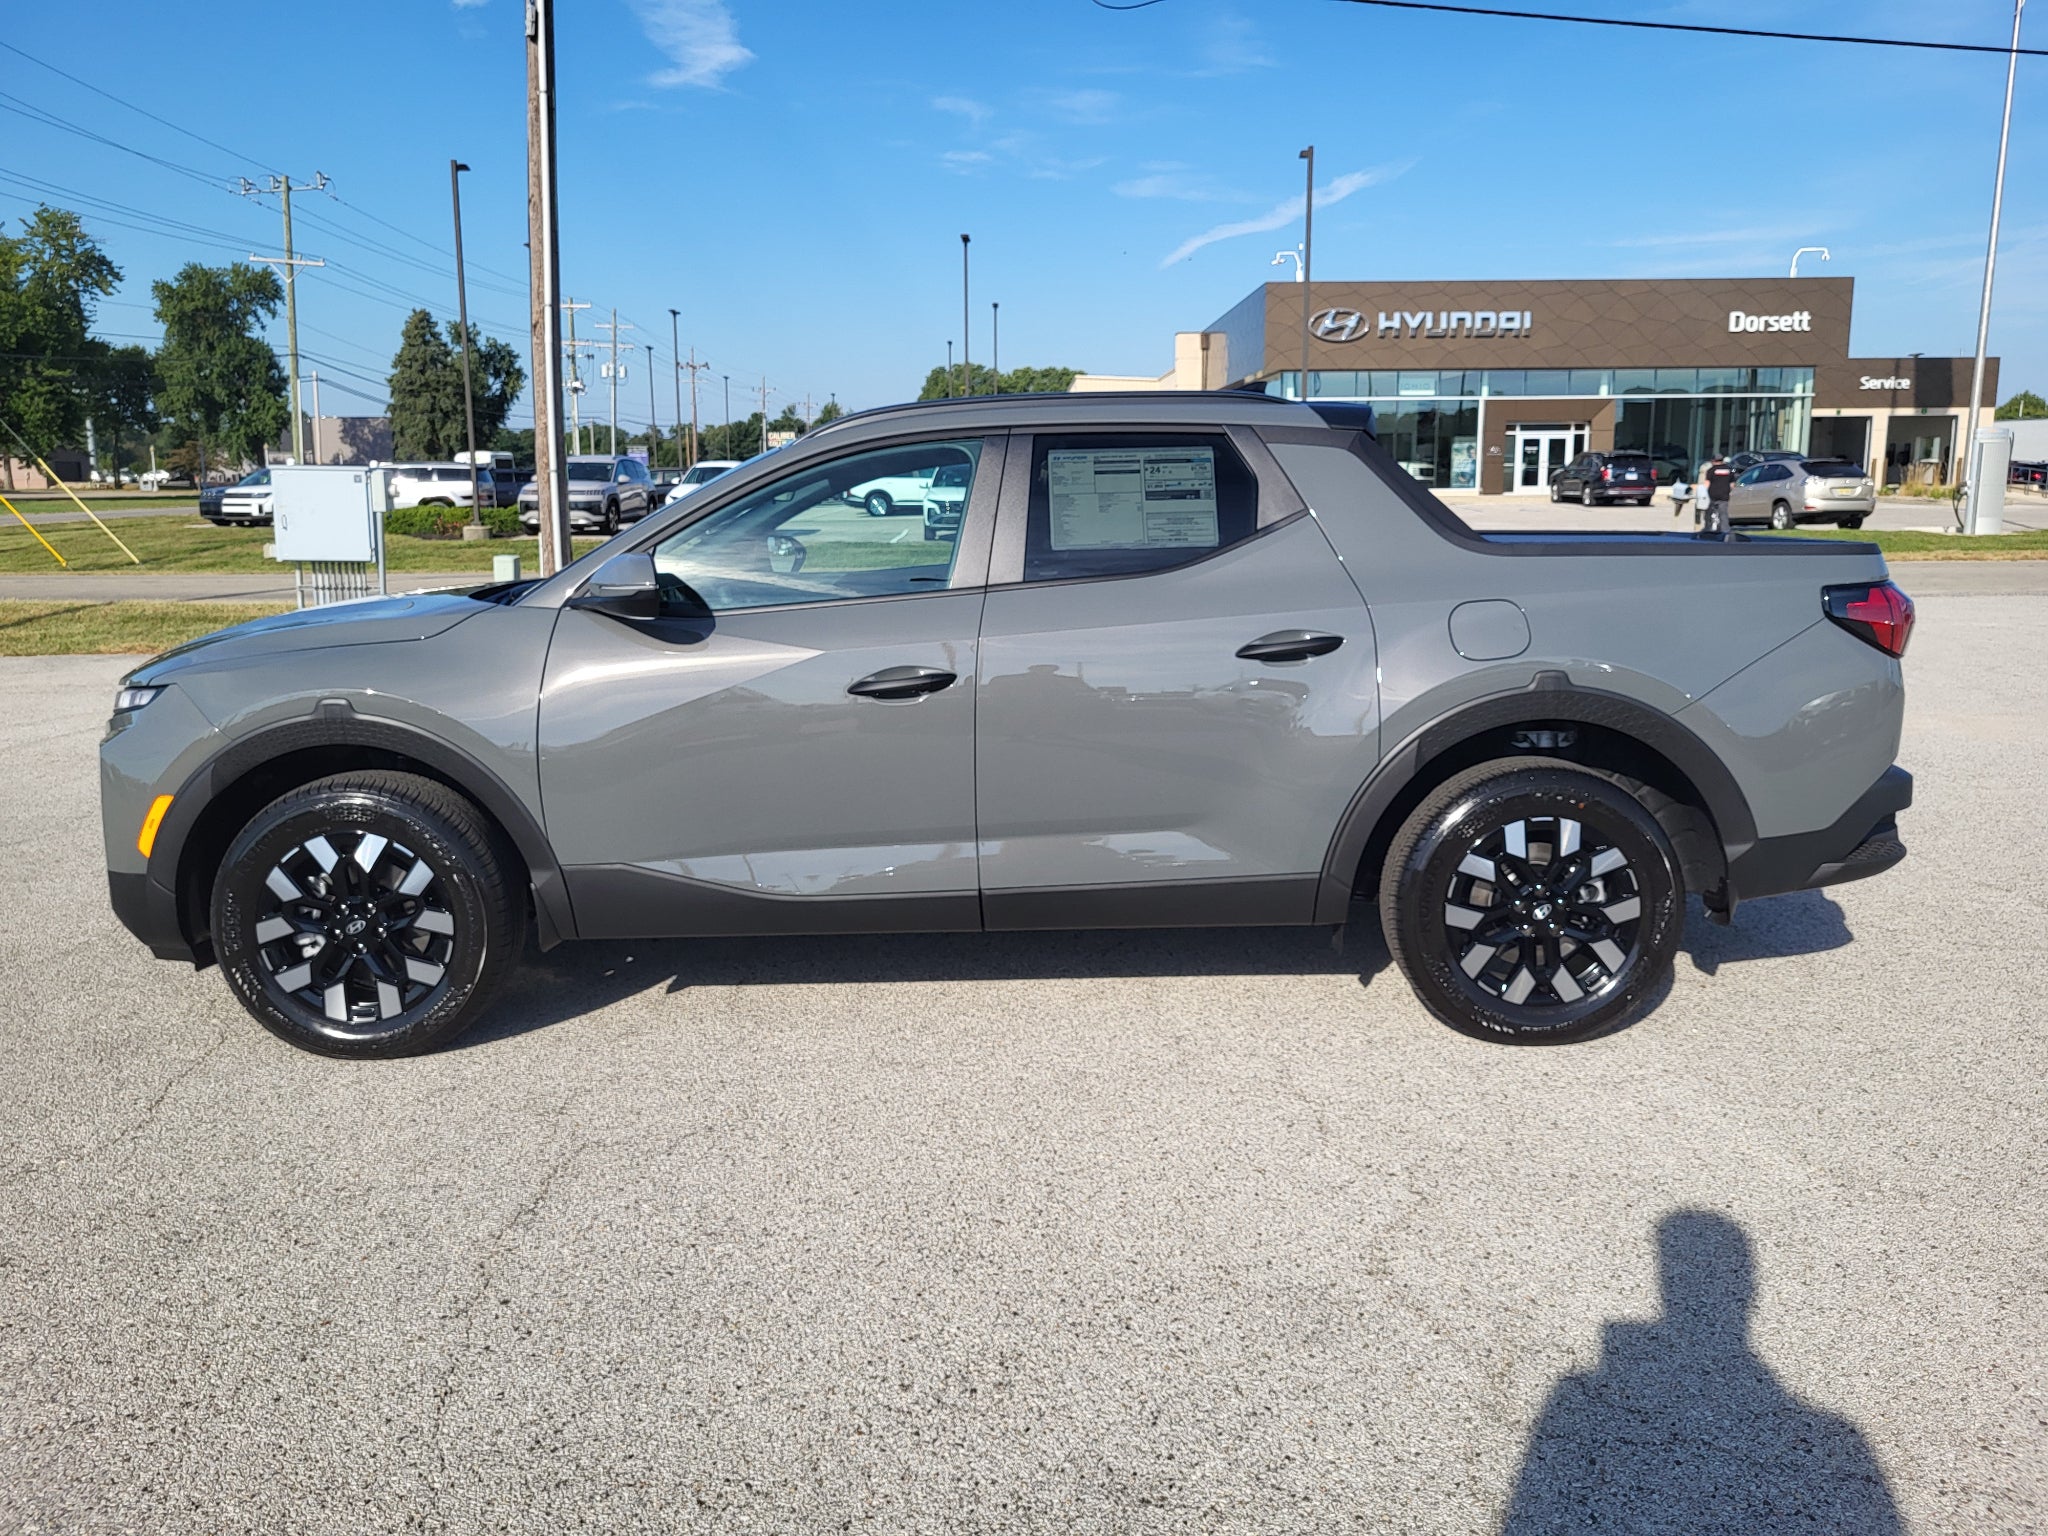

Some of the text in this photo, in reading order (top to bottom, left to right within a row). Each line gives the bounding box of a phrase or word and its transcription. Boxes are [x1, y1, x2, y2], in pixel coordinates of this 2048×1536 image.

[1378, 311, 1532, 339] HYUNDAI
[1728, 311, 1811, 332] Dorsett
[1859, 376, 1911, 390] Service
